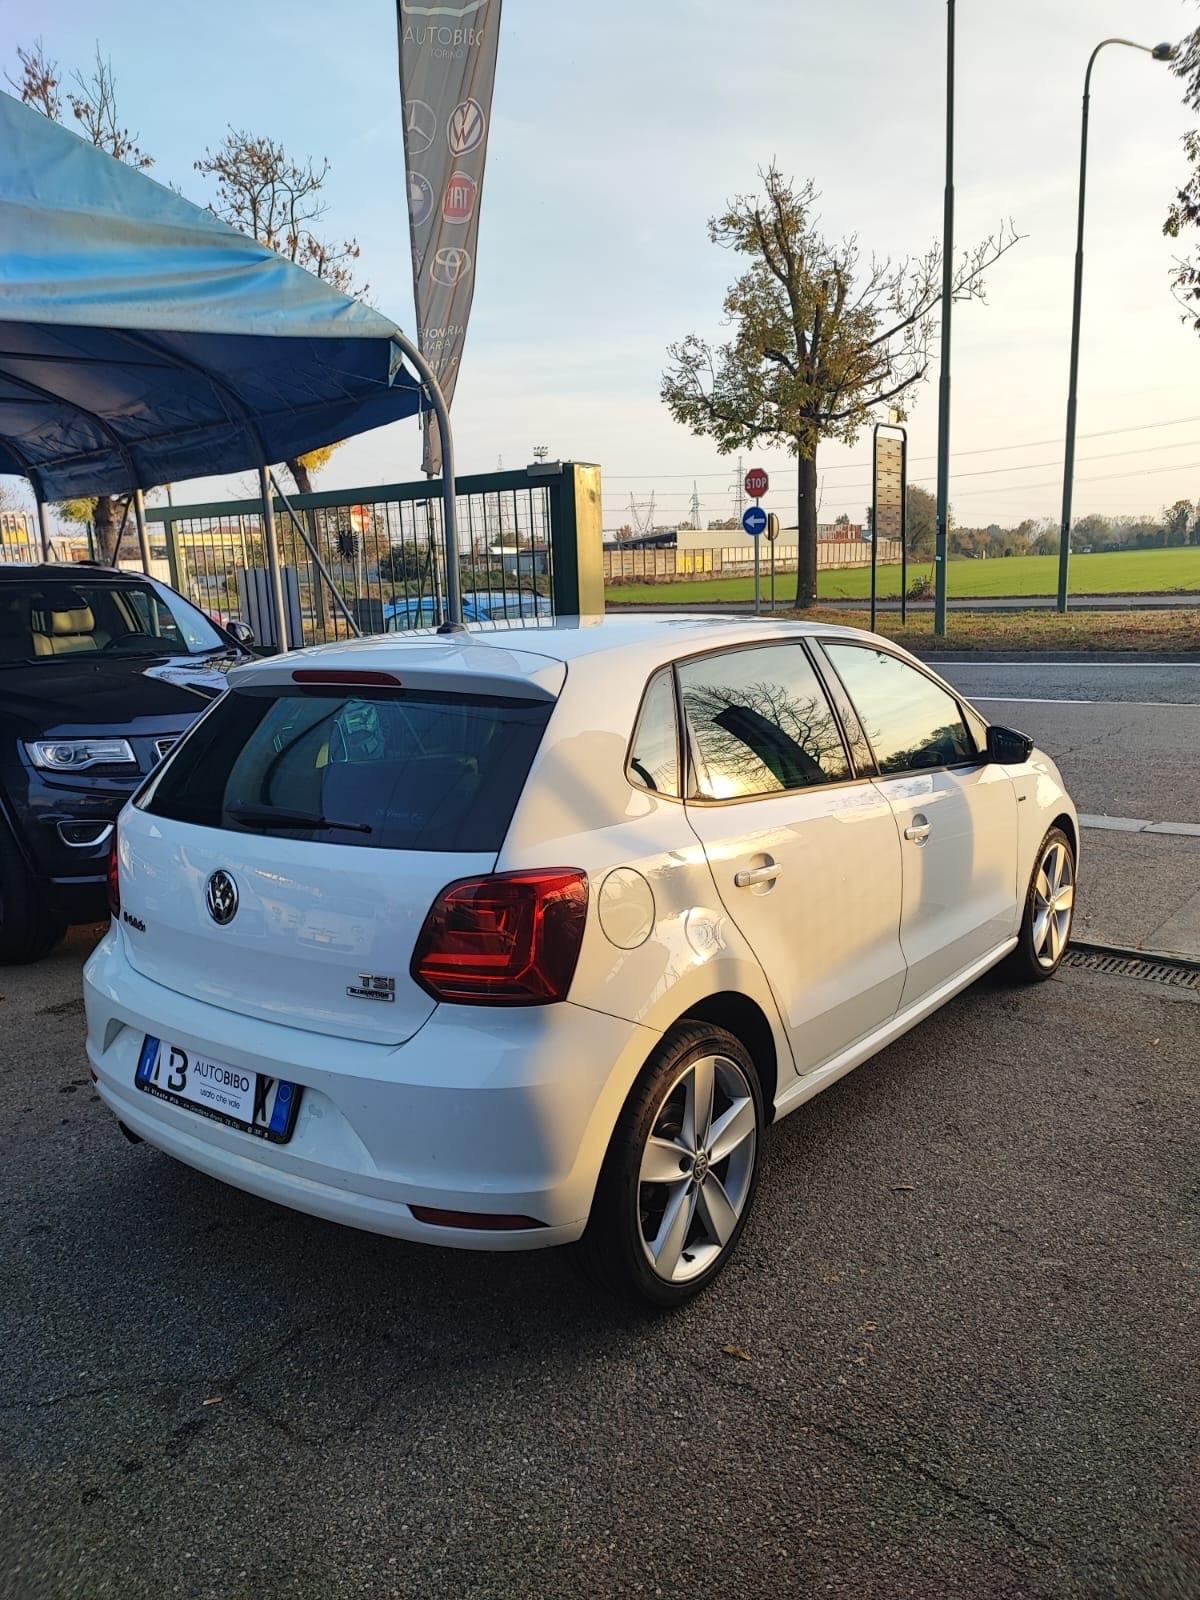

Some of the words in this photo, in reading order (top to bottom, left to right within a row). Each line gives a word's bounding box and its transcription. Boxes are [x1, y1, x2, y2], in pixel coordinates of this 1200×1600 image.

[746, 477, 767, 489] STOP
[193, 1061, 250, 1092] AUTOBIBO
[200, 1088, 216, 1100] usato
[215, 1093, 228, 1105] che
[228, 1099, 241, 1110] vale
